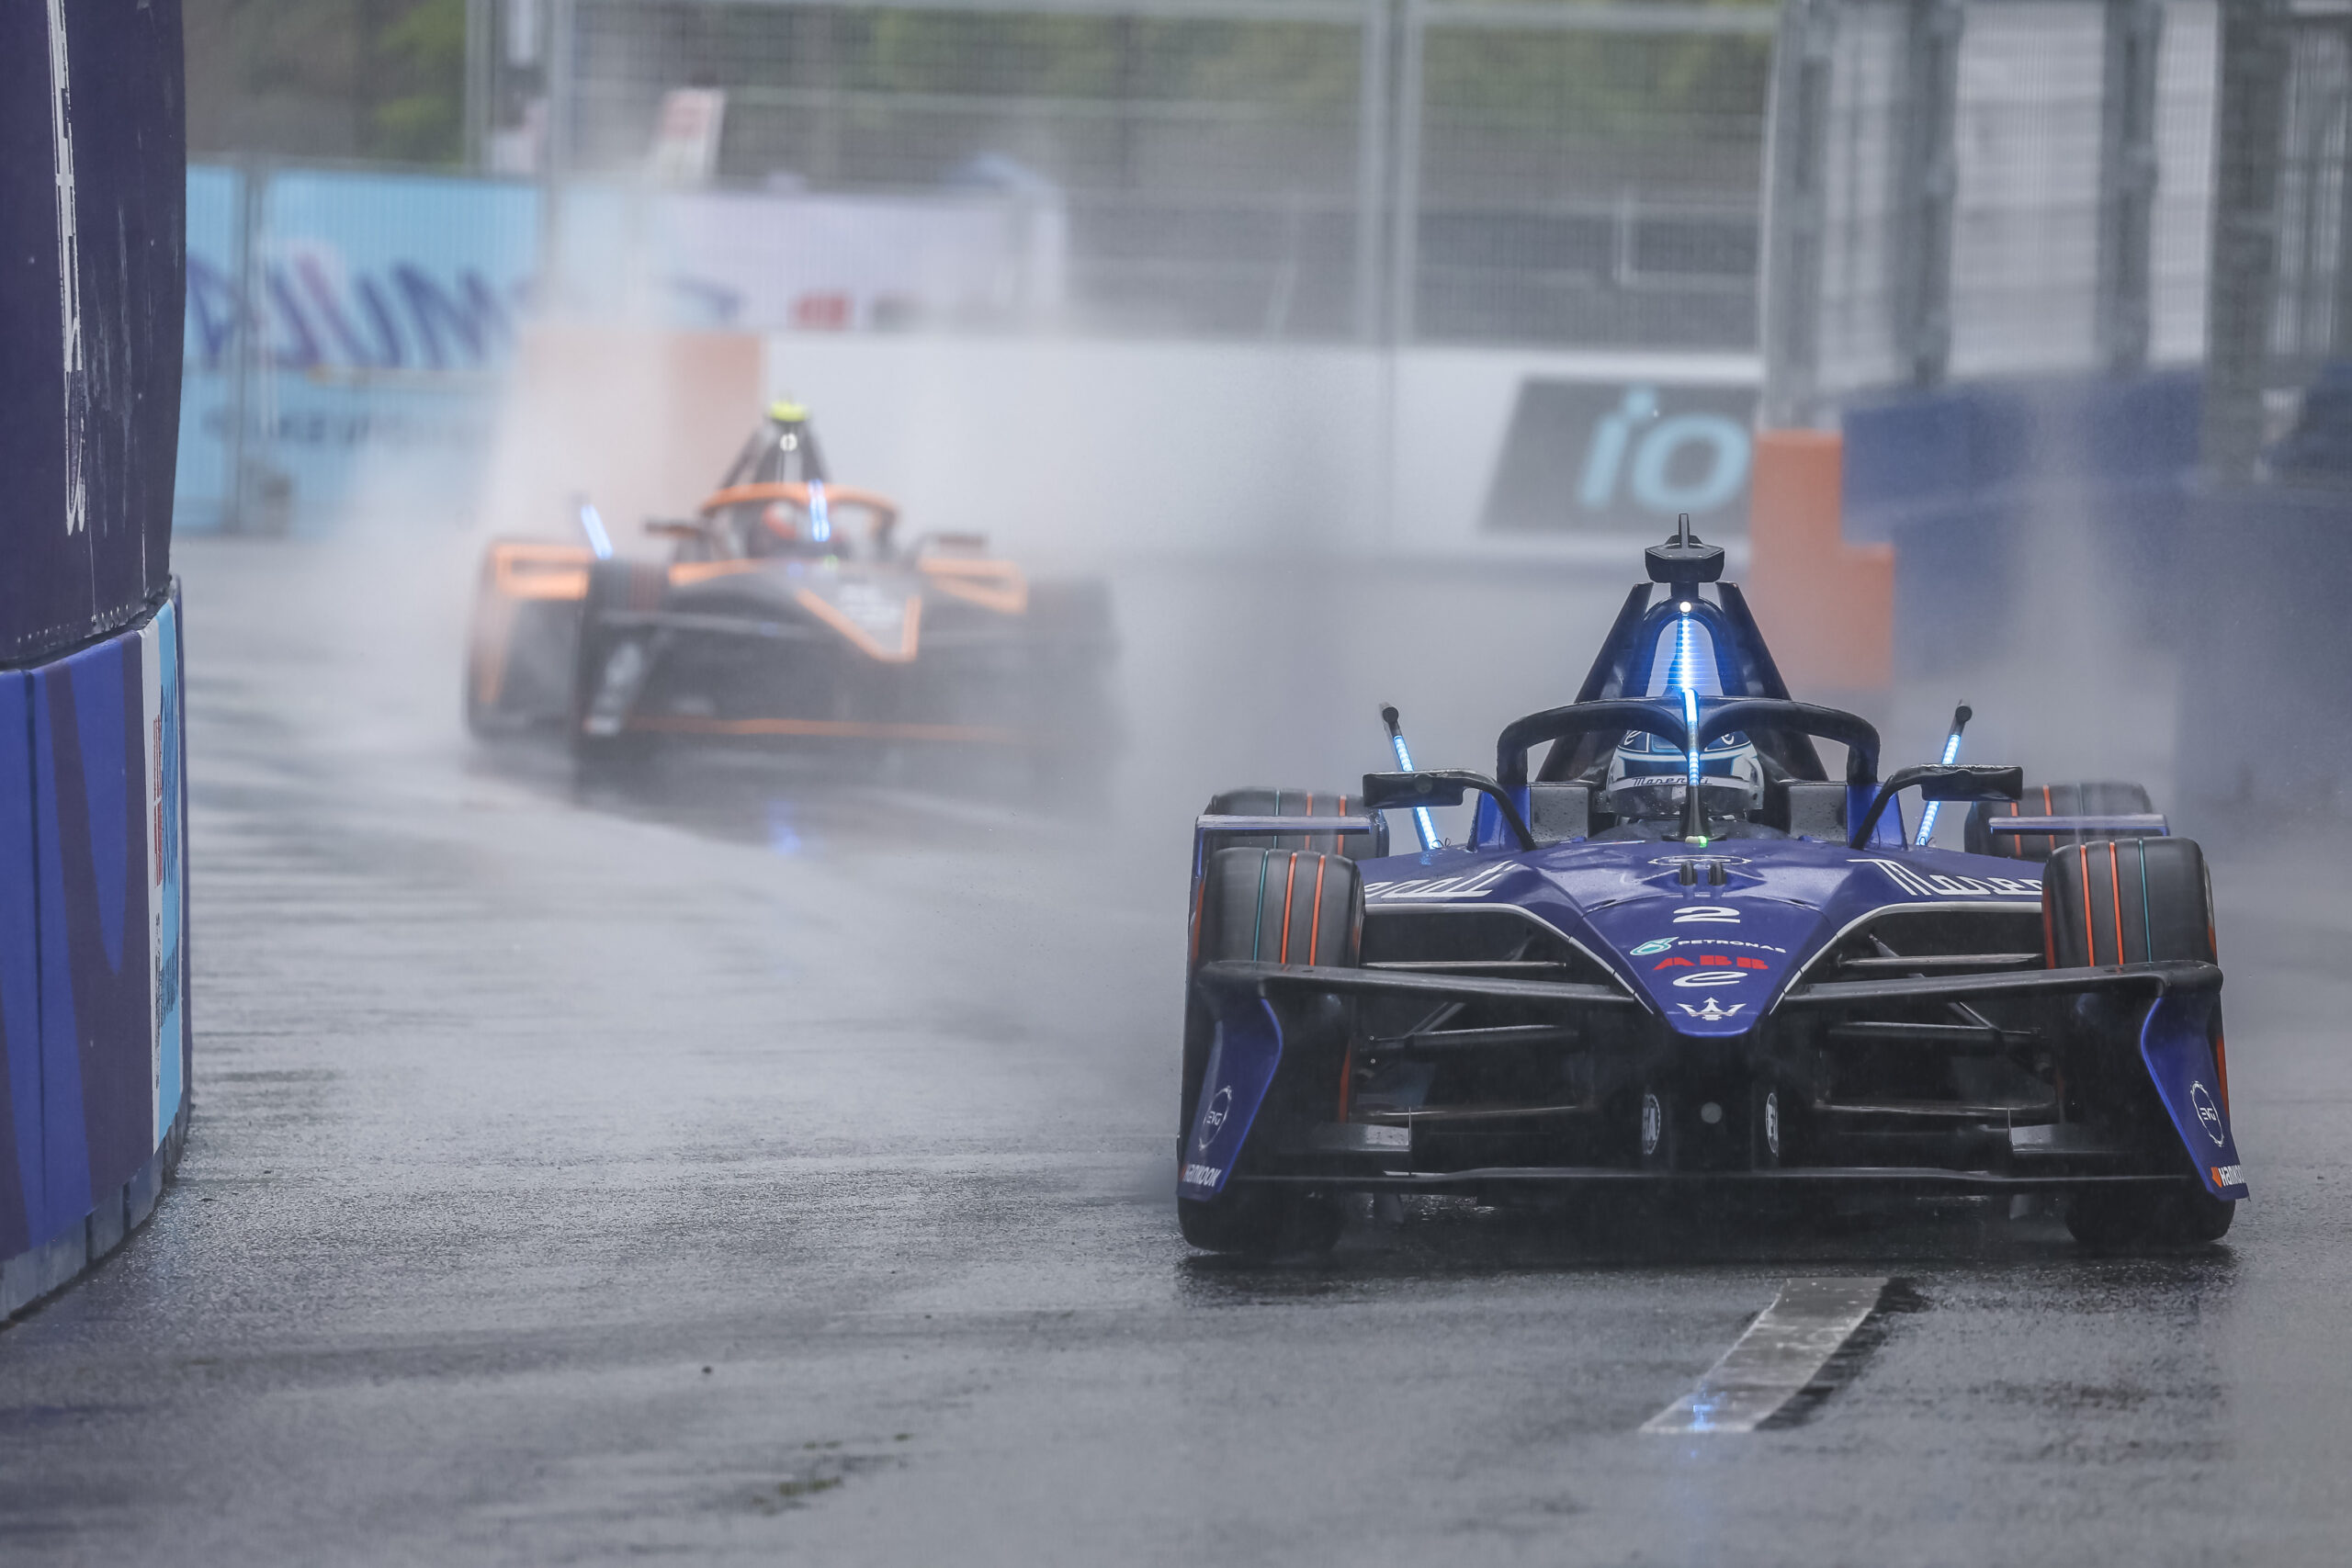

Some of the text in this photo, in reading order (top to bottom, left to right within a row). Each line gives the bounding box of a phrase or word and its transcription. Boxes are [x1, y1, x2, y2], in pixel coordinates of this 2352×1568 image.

[1672, 906, 1741, 924] 2
[1678, 939, 1787, 953] PETRONAS
[1653, 954, 1770, 971] ABB
